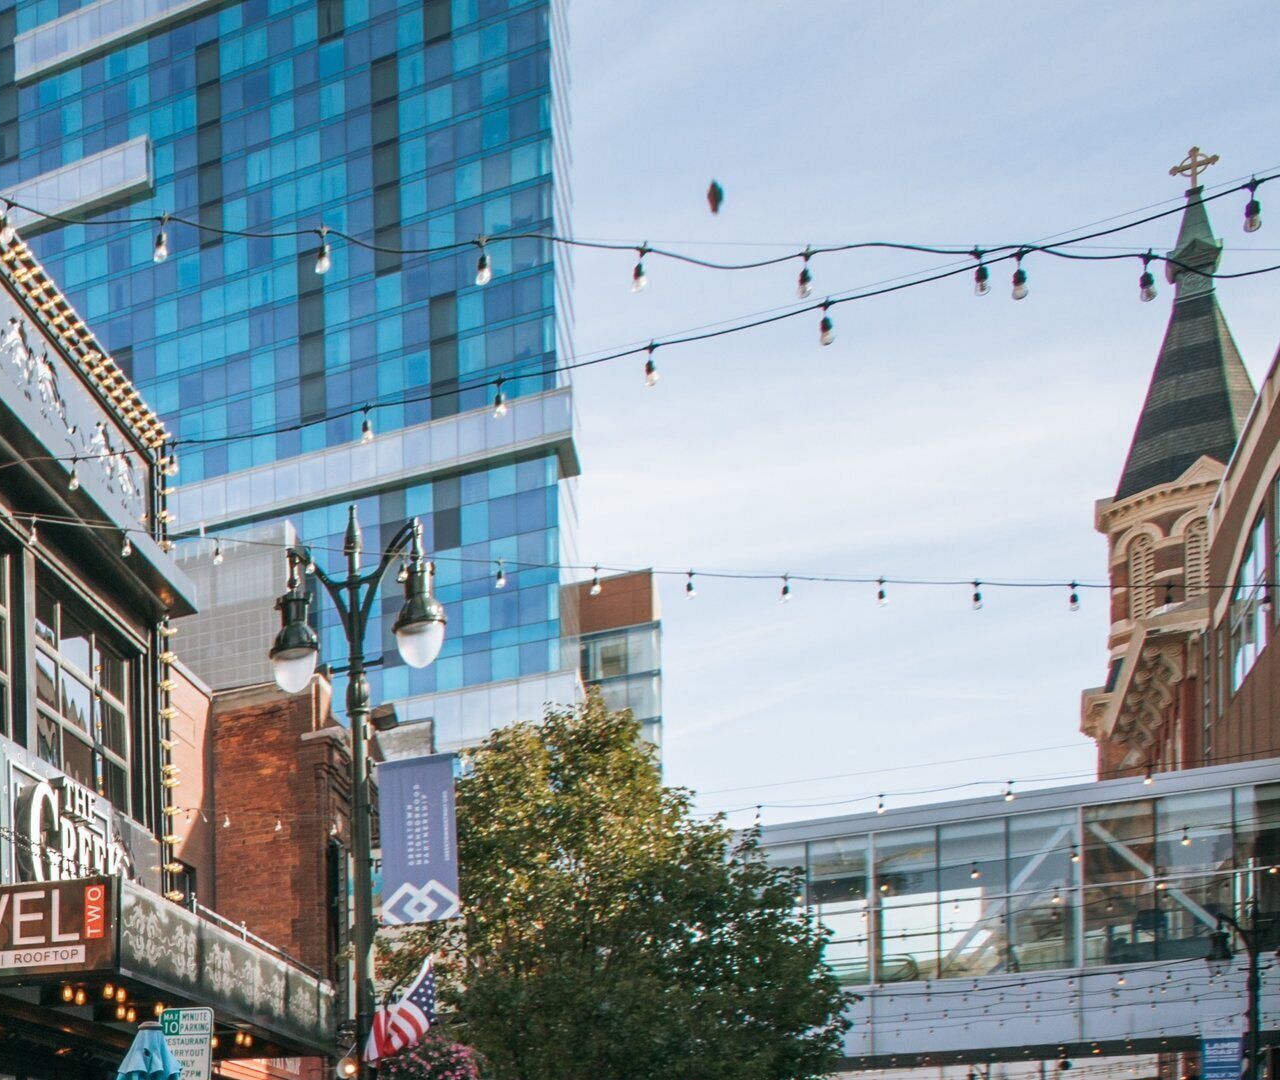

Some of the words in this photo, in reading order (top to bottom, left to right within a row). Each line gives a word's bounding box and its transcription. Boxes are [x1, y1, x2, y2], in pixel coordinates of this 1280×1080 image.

[63, 777, 97, 824] THE
[406, 804, 415, 866] GREEKTOWN
[413, 784, 422, 865] NEIGHBORHOOD
[421, 794, 430, 865] PARTNERSHIP
[86, 886, 102, 937] TWO
[13, 949, 79, 964] ROOFTOP
[163, 1012, 179, 1021] MAX
[181, 1012, 208, 1021] MINUTE
[164, 1021, 179, 1034] 10
[180, 1023, 209, 1032] PARKING
[170, 1049, 205, 1057] ARRYOUT
[178, 1070, 202, 1078] -7PM
